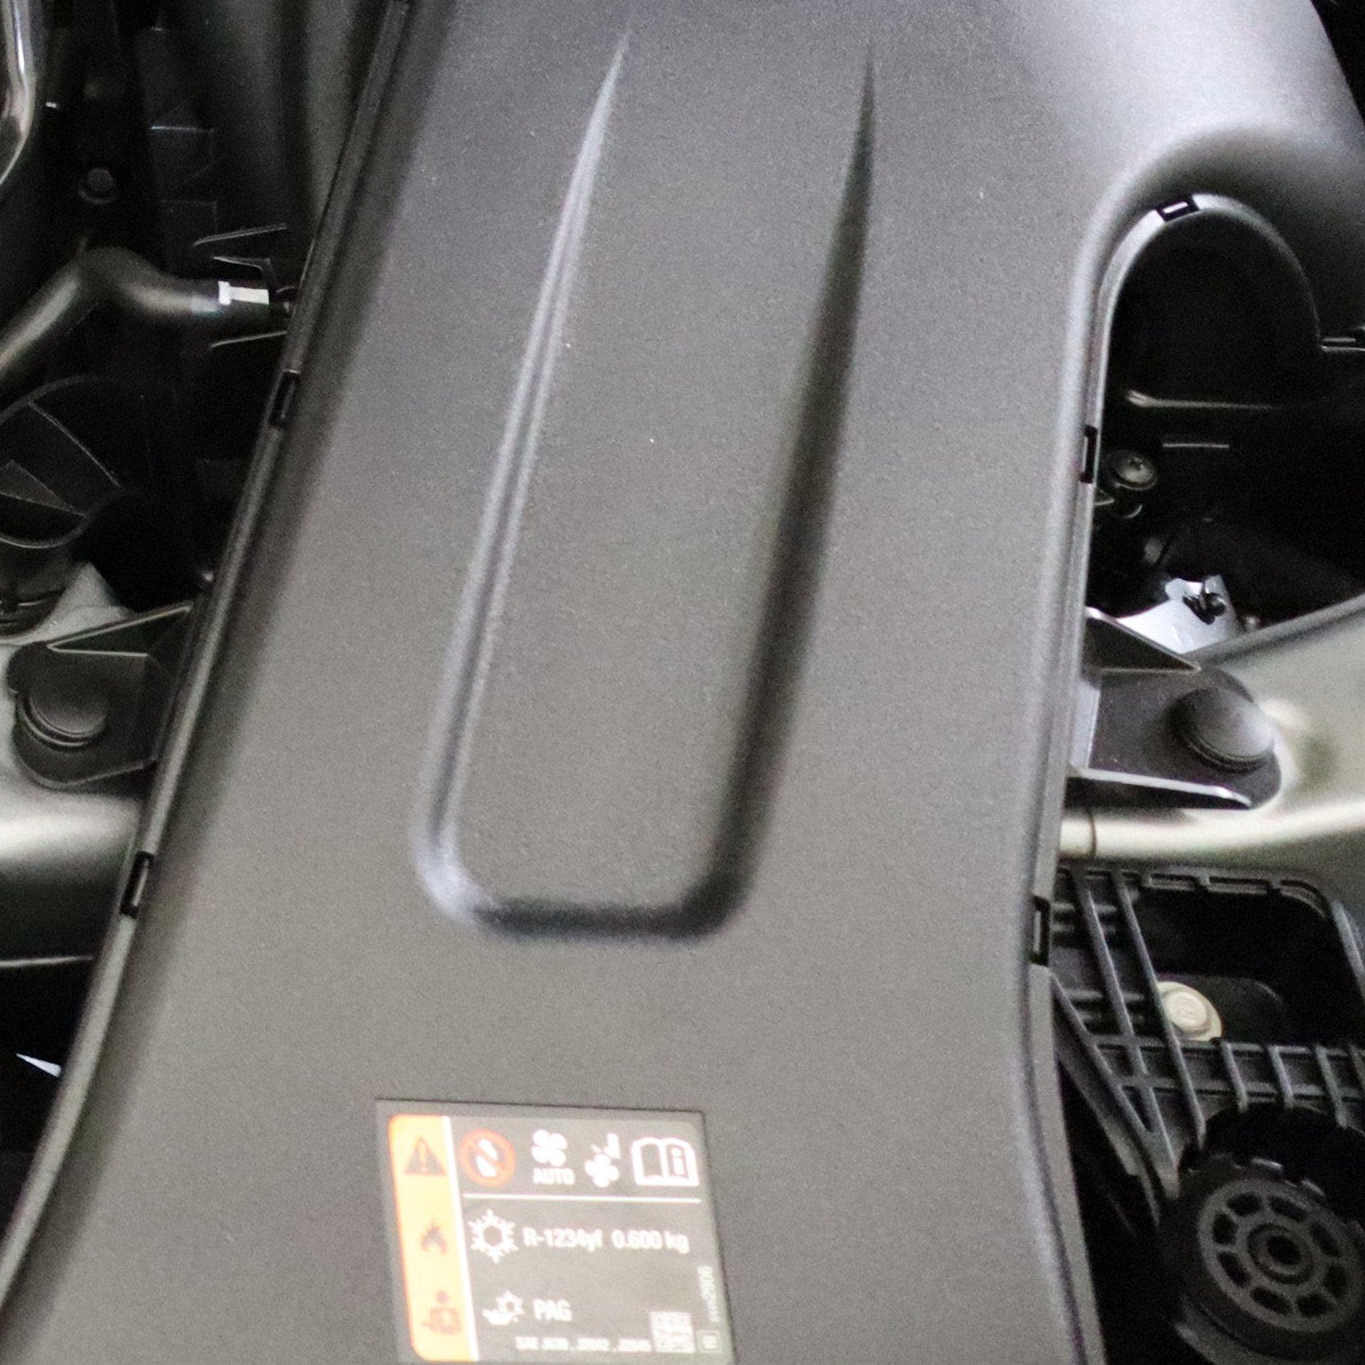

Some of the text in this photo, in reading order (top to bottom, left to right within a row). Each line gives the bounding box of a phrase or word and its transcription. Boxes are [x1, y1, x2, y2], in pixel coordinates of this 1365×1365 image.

[531, 1168, 575, 1186] AUTO
[611, 1229, 662, 1250] 0.600
[665, 1232, 690, 1254] kg
[532, 1298, 573, 1322] PAG
